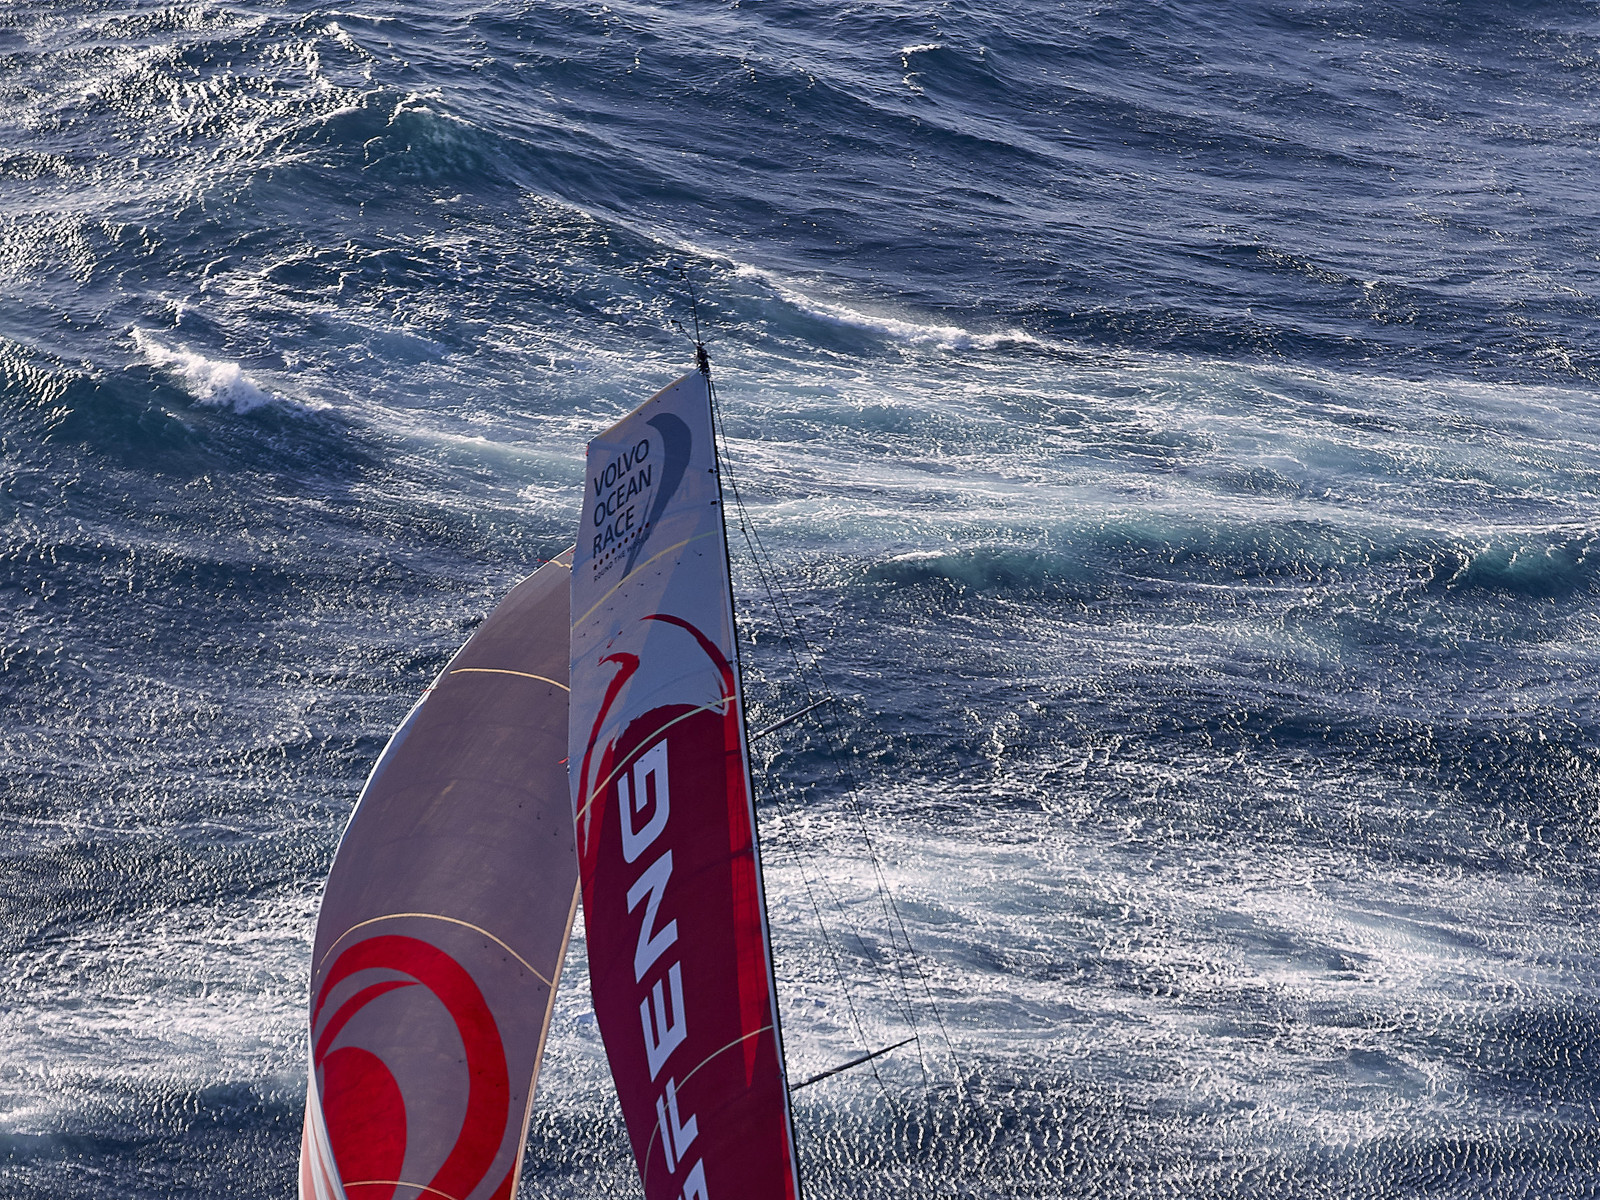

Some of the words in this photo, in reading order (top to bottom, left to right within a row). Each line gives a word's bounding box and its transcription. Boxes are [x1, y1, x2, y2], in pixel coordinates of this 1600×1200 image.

[593, 438, 650, 497] VOLVO
[594, 464, 652, 527] OCEAN
[593, 504, 635, 559] RACE
